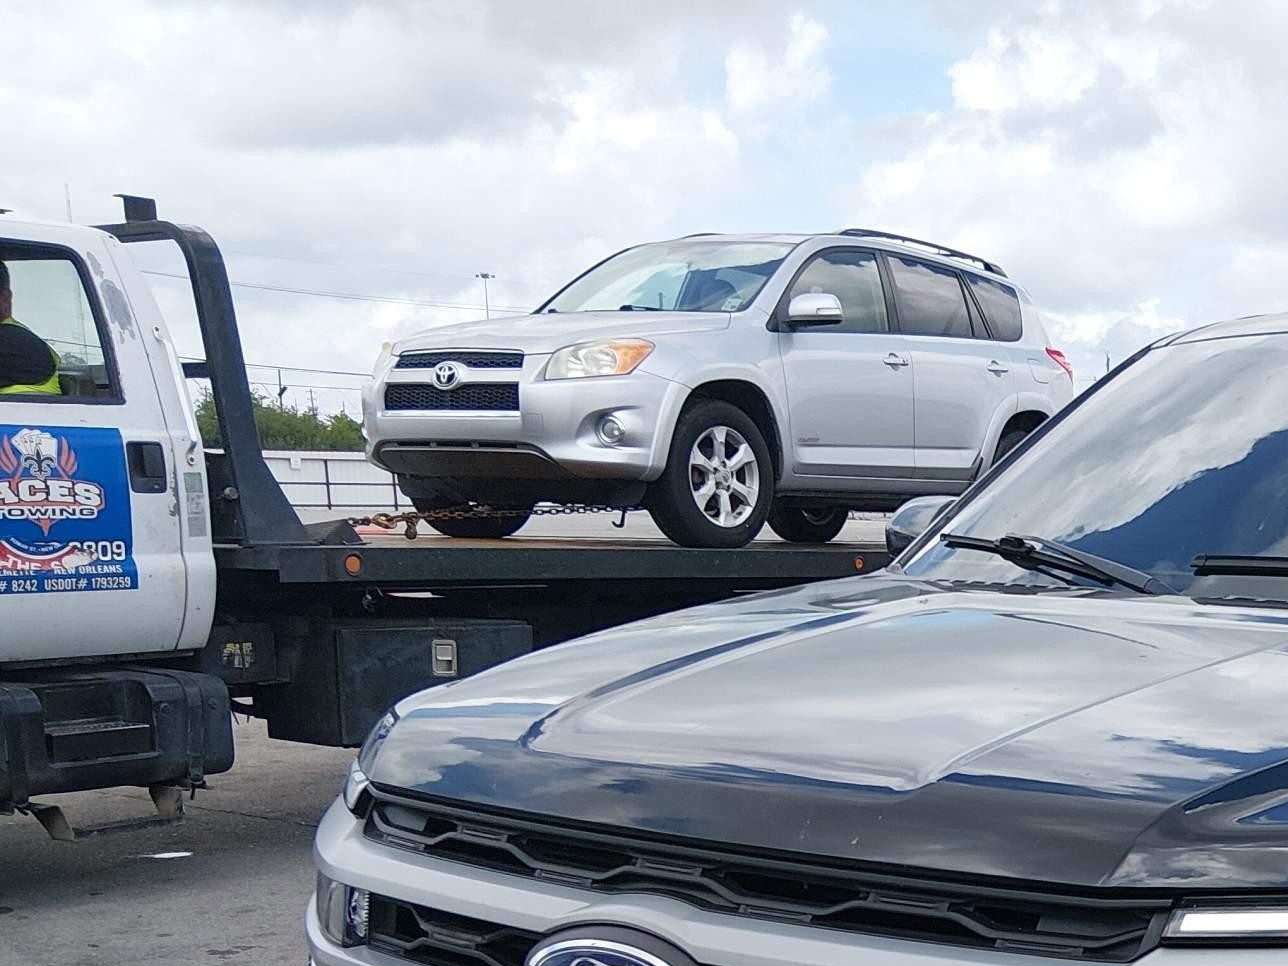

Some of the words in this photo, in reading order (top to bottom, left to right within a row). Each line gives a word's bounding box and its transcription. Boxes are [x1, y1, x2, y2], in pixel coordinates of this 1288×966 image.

[79, 564, 123, 574] ORLEANS
[11, 579, 38, 592] 8242
[44, 577, 88, 591] USDOT#
[91, 576, 131, 589] 1793259
